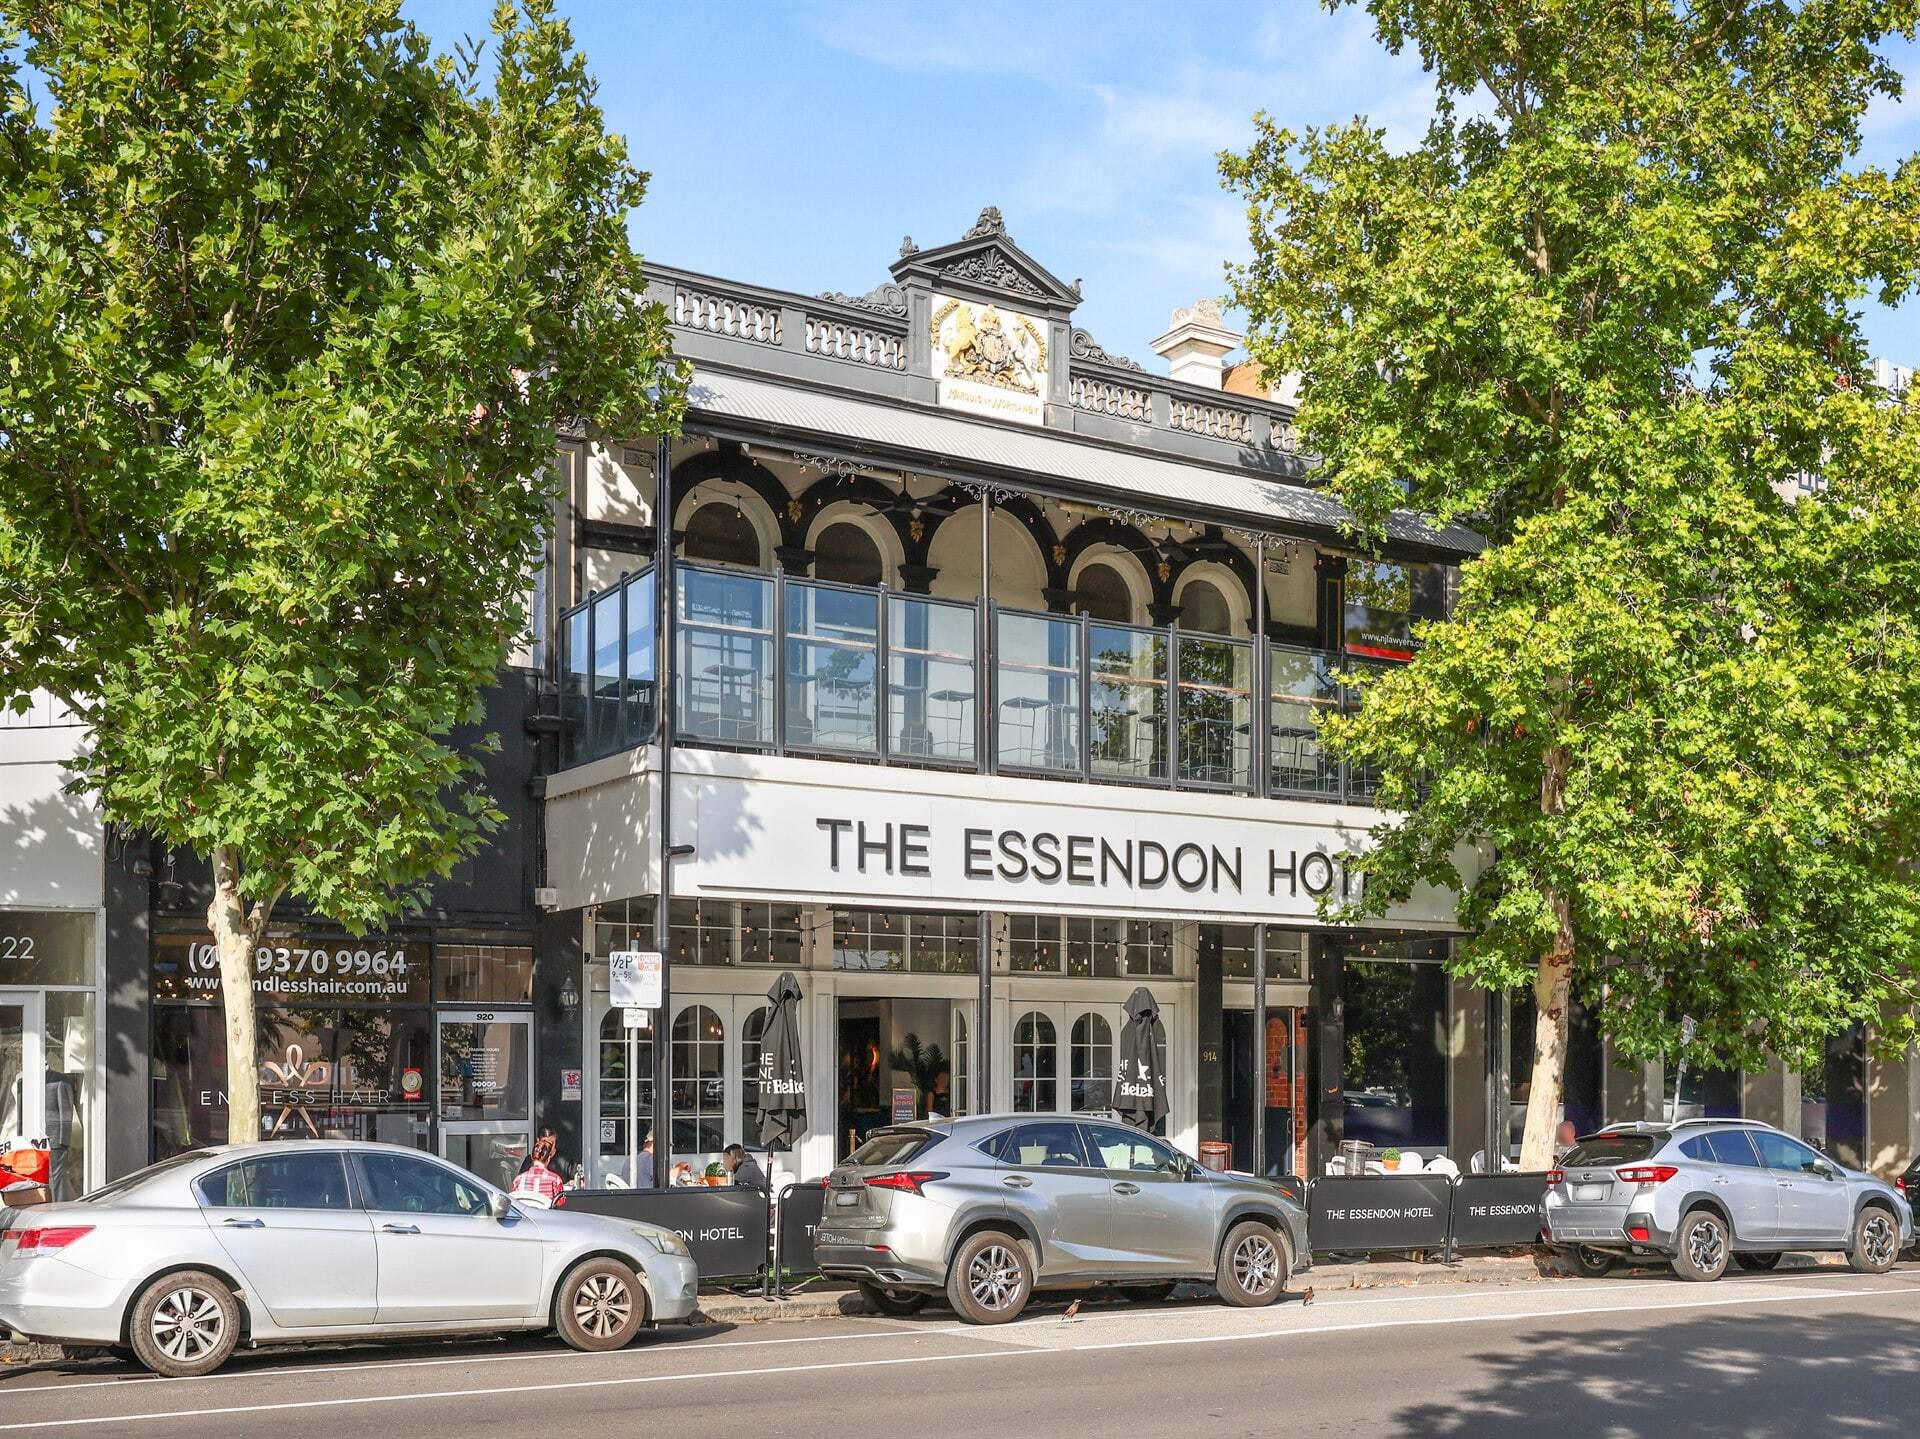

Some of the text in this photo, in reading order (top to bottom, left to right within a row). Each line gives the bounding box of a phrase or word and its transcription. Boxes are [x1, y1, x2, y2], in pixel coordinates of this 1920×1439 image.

[816, 817, 1370, 897] THE ESSENDON HOT
[256, 947, 329, 975] 9370
[335, 950, 407, 976] 9964
[188, 976, 408, 994] wwndlesshair.com.au
[476, 1013, 494, 1021] 920
[1203, 1051, 1217, 1062] 914
[331, 1089, 390, 1105] HAIR
[1326, 1207, 1434, 1220] THE ESSENDON HOTEL
[1469, 1206, 1487, 1217] THE
[1489, 1204, 1536, 1216] ESSENDON
[700, 1229, 744, 1242] HOTEL
